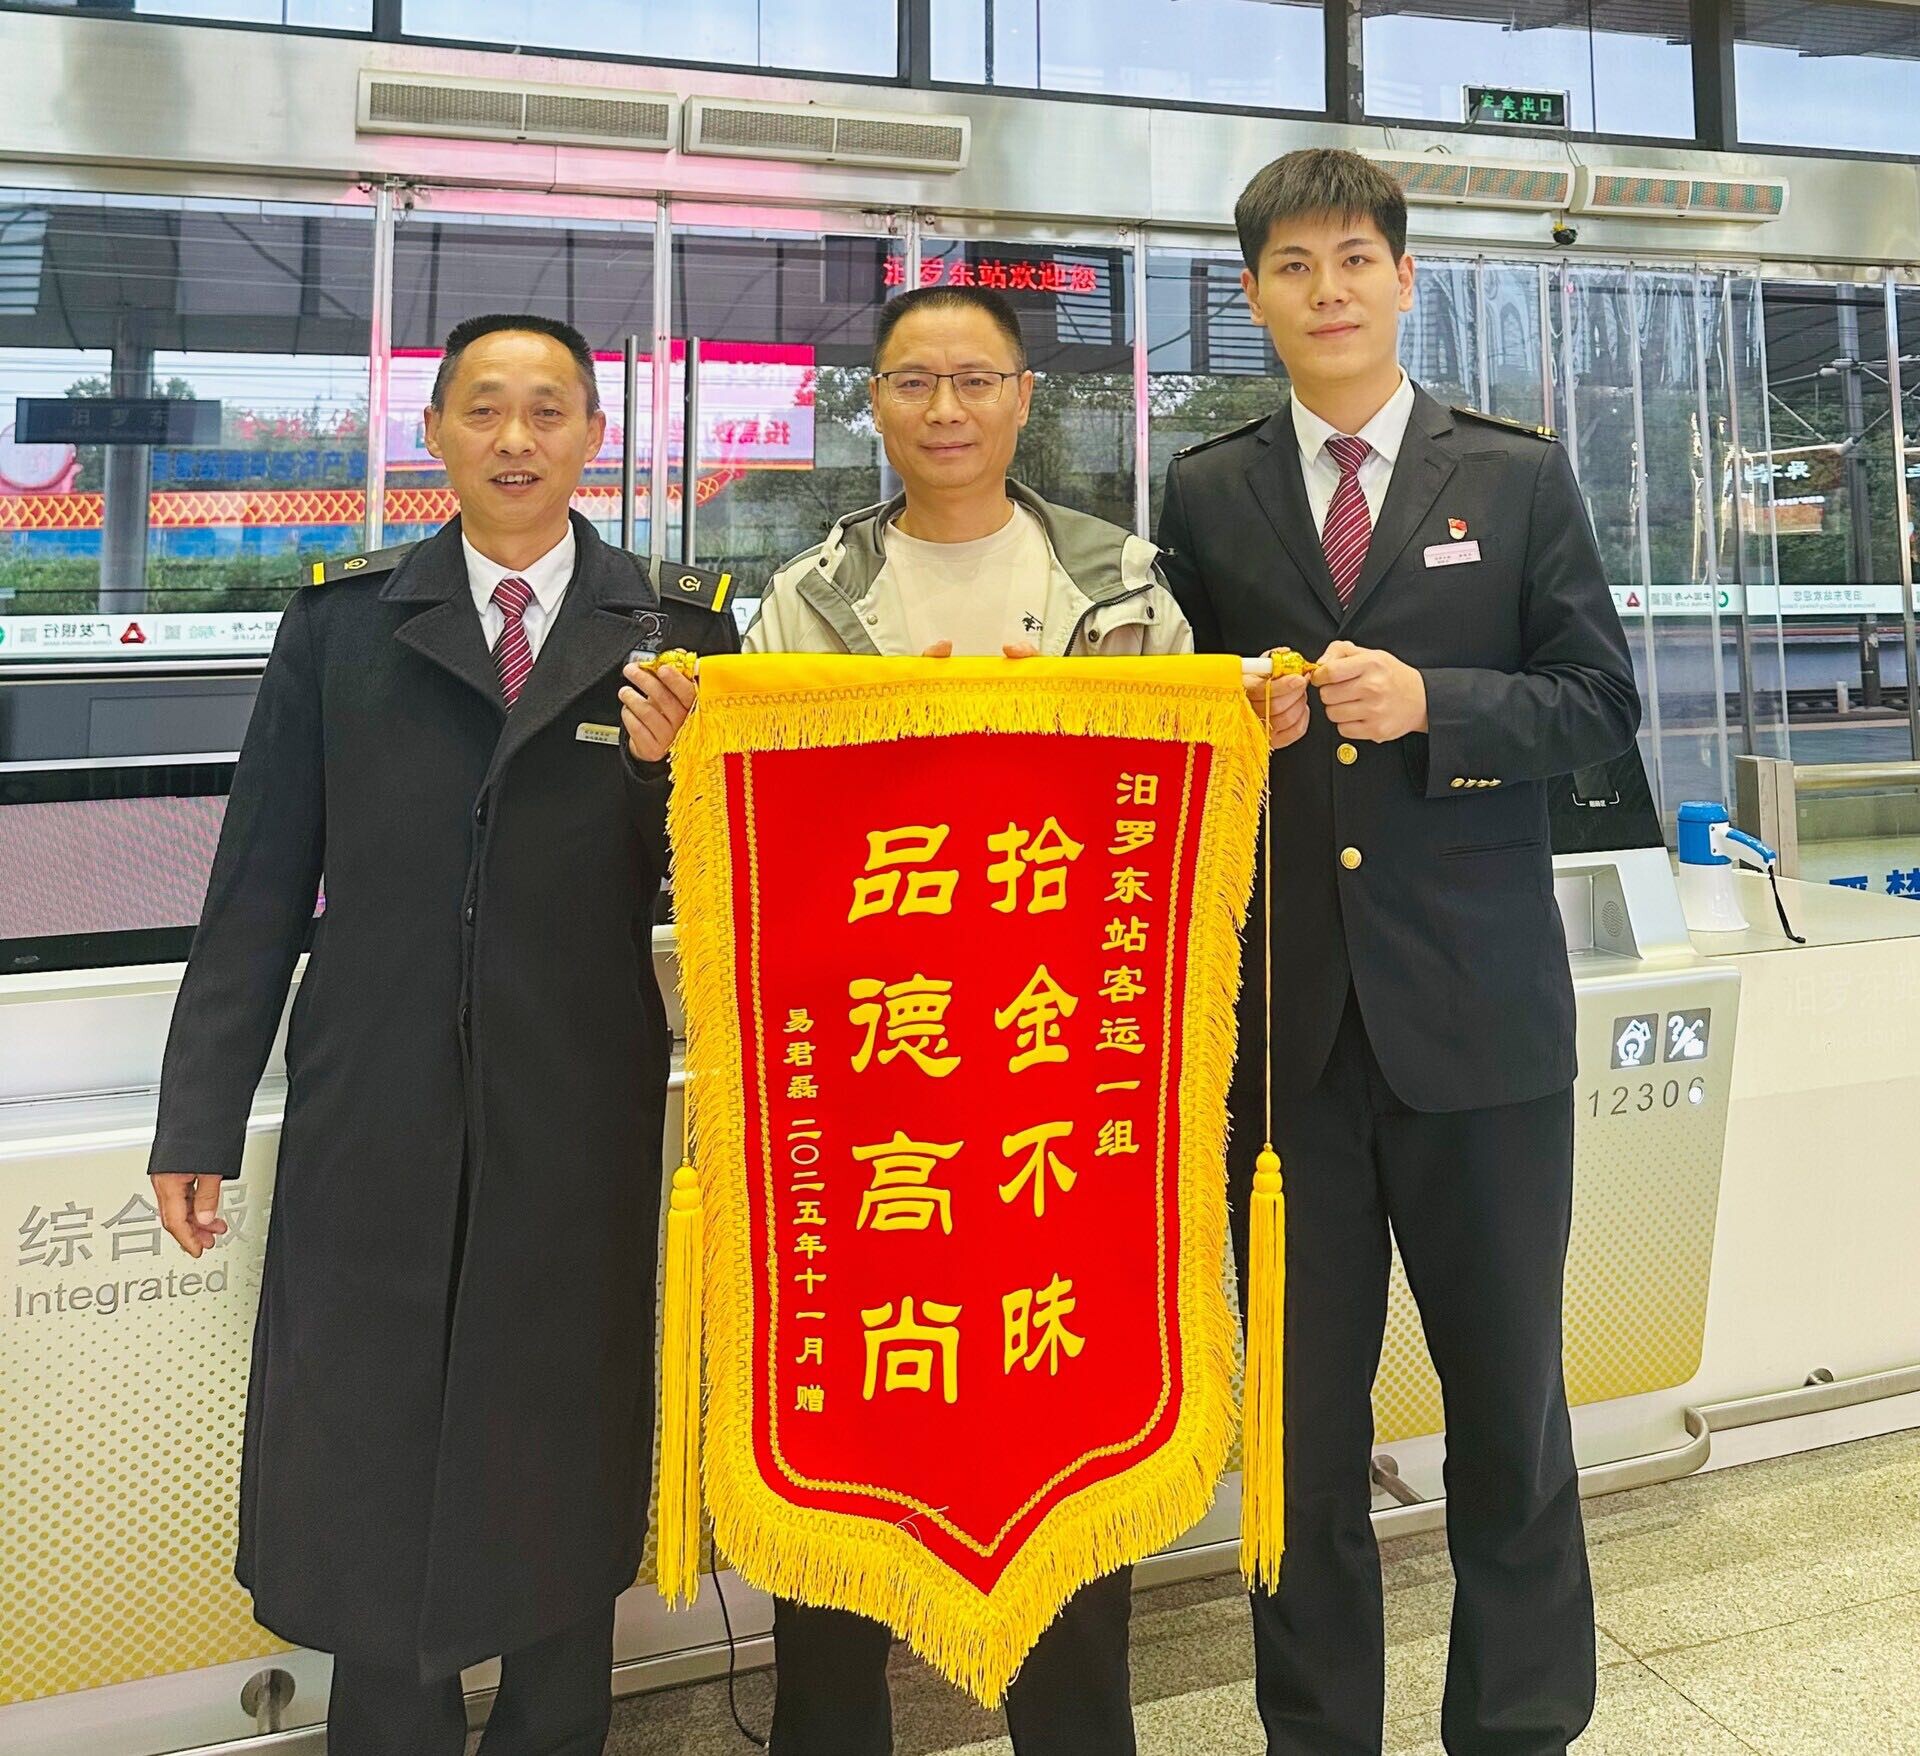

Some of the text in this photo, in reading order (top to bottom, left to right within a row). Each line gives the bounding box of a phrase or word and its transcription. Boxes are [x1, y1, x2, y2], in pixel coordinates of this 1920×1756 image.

[1481, 91, 1552, 112] 安全出口
[1493, 109, 1540, 120] EXIT
[1094, 771, 1159, 1158] 汨罗东站客运一组
[846, 822, 966, 1405] 品德高尚
[986, 815, 1086, 1377] 拾金不昧
[1588, 1076, 1705, 1118] 12306
[15, 1260, 229, 1318] Integrated
